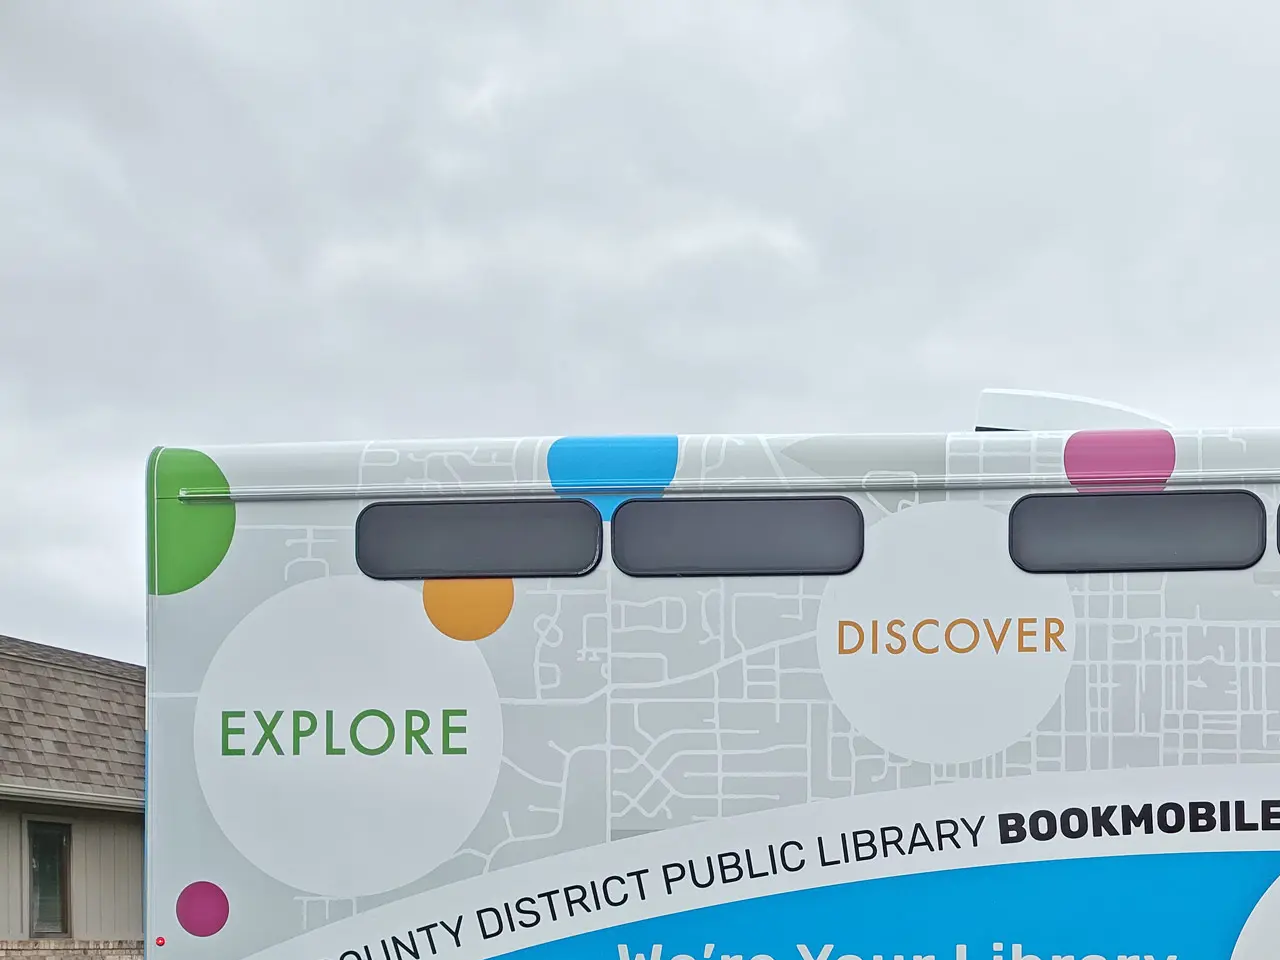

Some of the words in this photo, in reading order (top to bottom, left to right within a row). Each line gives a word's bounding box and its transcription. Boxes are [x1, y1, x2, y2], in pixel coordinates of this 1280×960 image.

[838, 617, 1066, 656] DISCOVER
[221, 709, 468, 757] EXPLORE
[475, 867, 651, 941] DISTRICT
[661, 839, 807, 896] PUBLIC
[816, 814, 986, 868] LIBRARY
